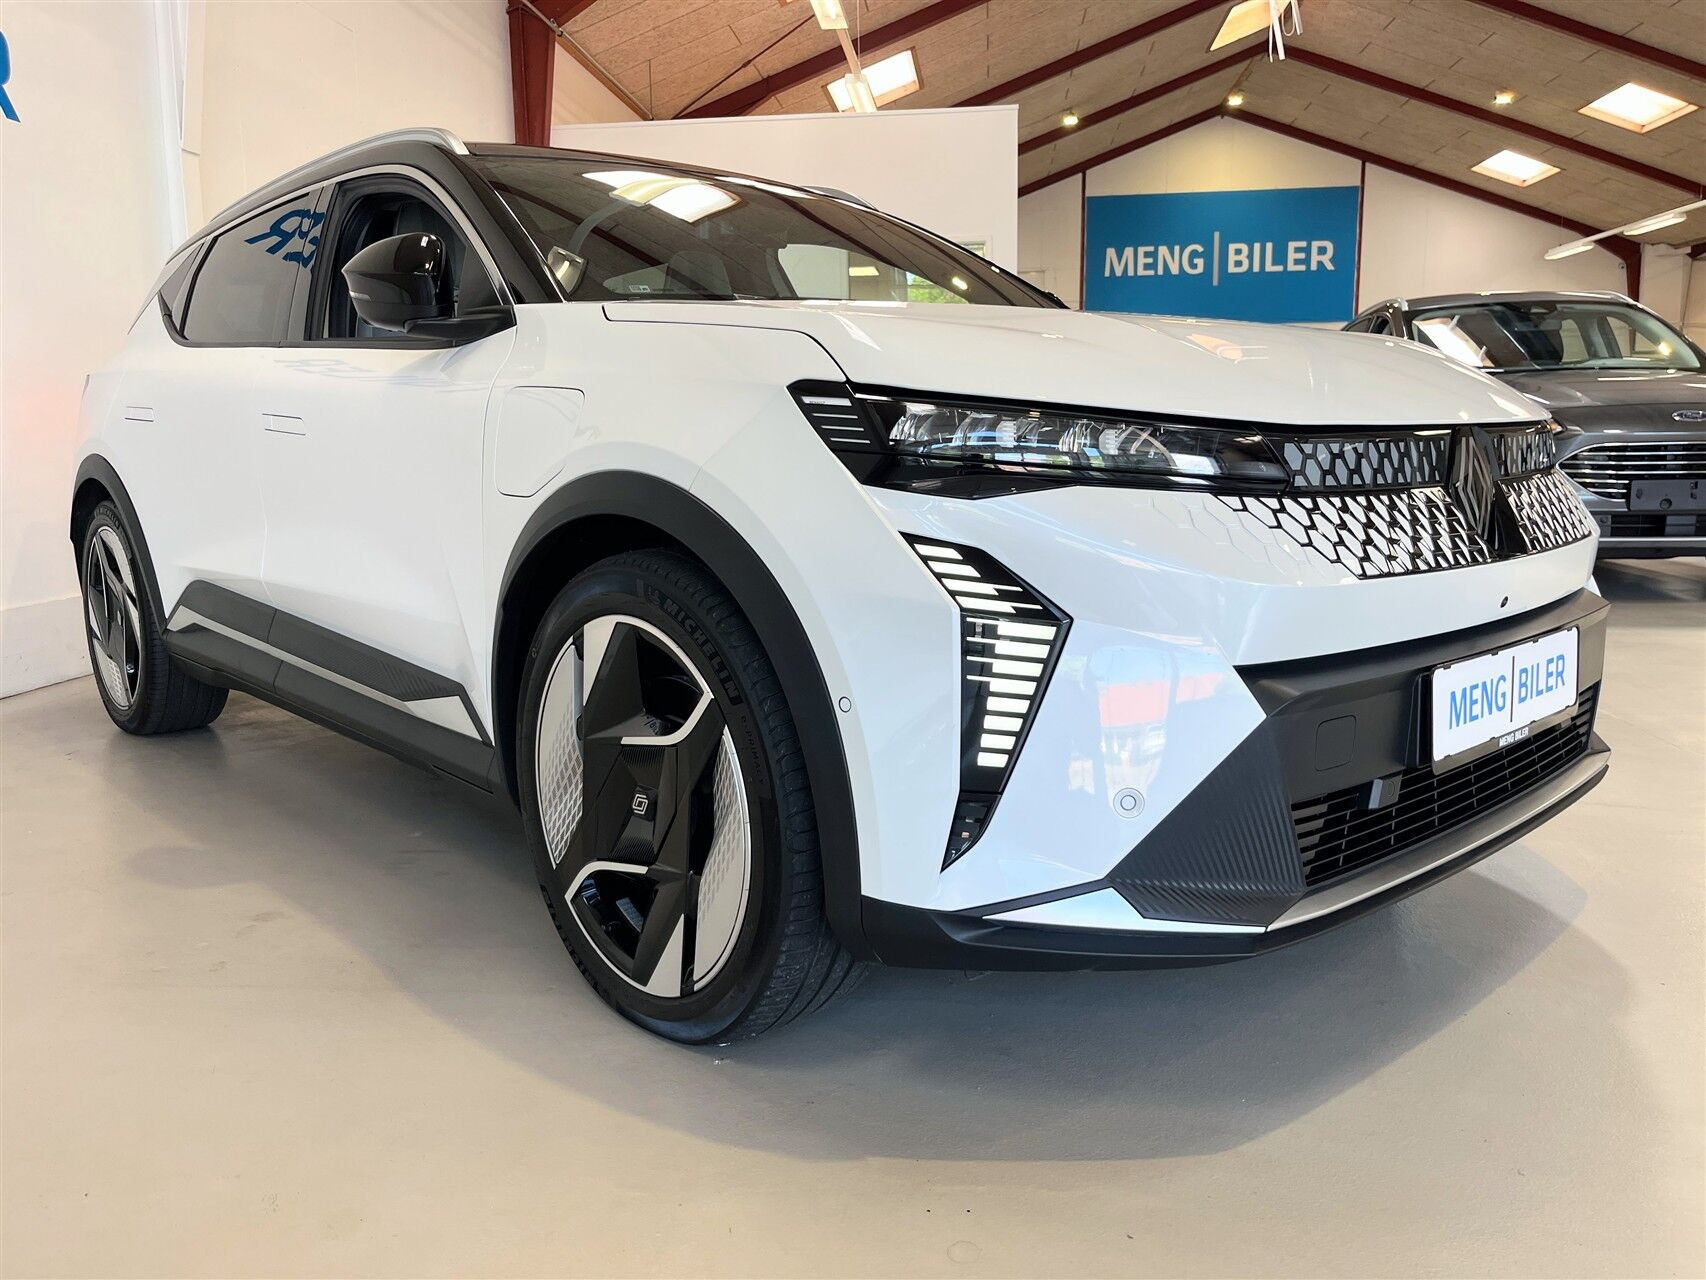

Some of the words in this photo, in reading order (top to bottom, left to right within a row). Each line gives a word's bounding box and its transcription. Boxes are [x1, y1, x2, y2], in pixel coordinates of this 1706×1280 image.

[1104, 244, 1205, 277] MENG
[1227, 240, 1336, 274] BILER
[663, 598, 739, 700] MICHELIN
[1449, 674, 1507, 730] MENG
[1518, 654, 1566, 704] BILER
[1499, 732, 1514, 748] MENG
[1514, 727, 1529, 741] BILER
